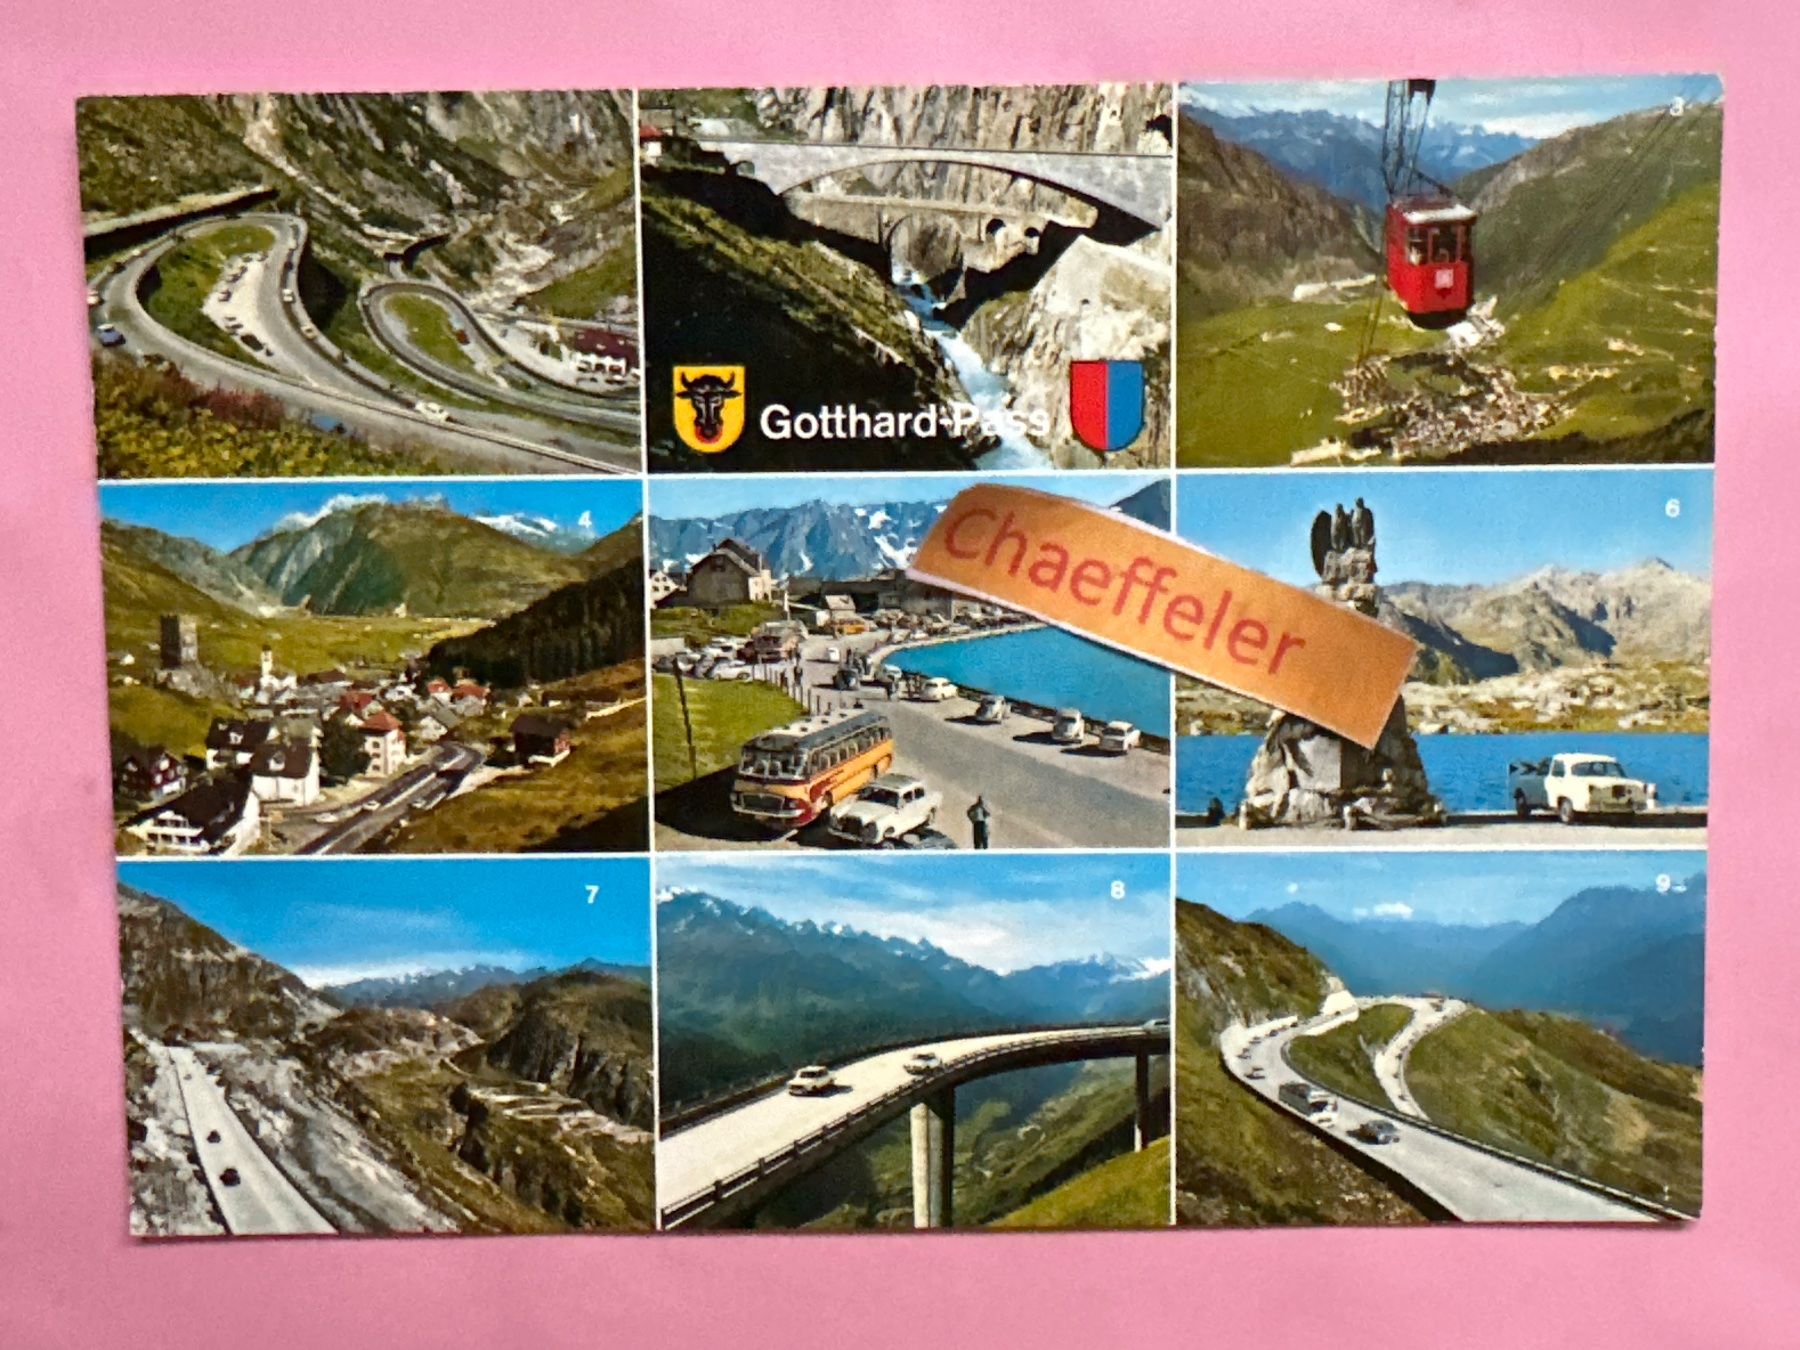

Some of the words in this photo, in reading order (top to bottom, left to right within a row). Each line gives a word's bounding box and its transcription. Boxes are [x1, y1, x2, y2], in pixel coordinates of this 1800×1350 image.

[1669, 96, 1684, 117] 3
[760, 403, 1051, 440] Gotthard-Pass
[1665, 498, 1681, 518] 6
[577, 509, 593, 529] 4
[943, 507, 1306, 675] Chaeffeler
[1110, 880, 1126, 900] 8
[1655, 873, 1671, 894] 9
[585, 884, 599, 904] 7
